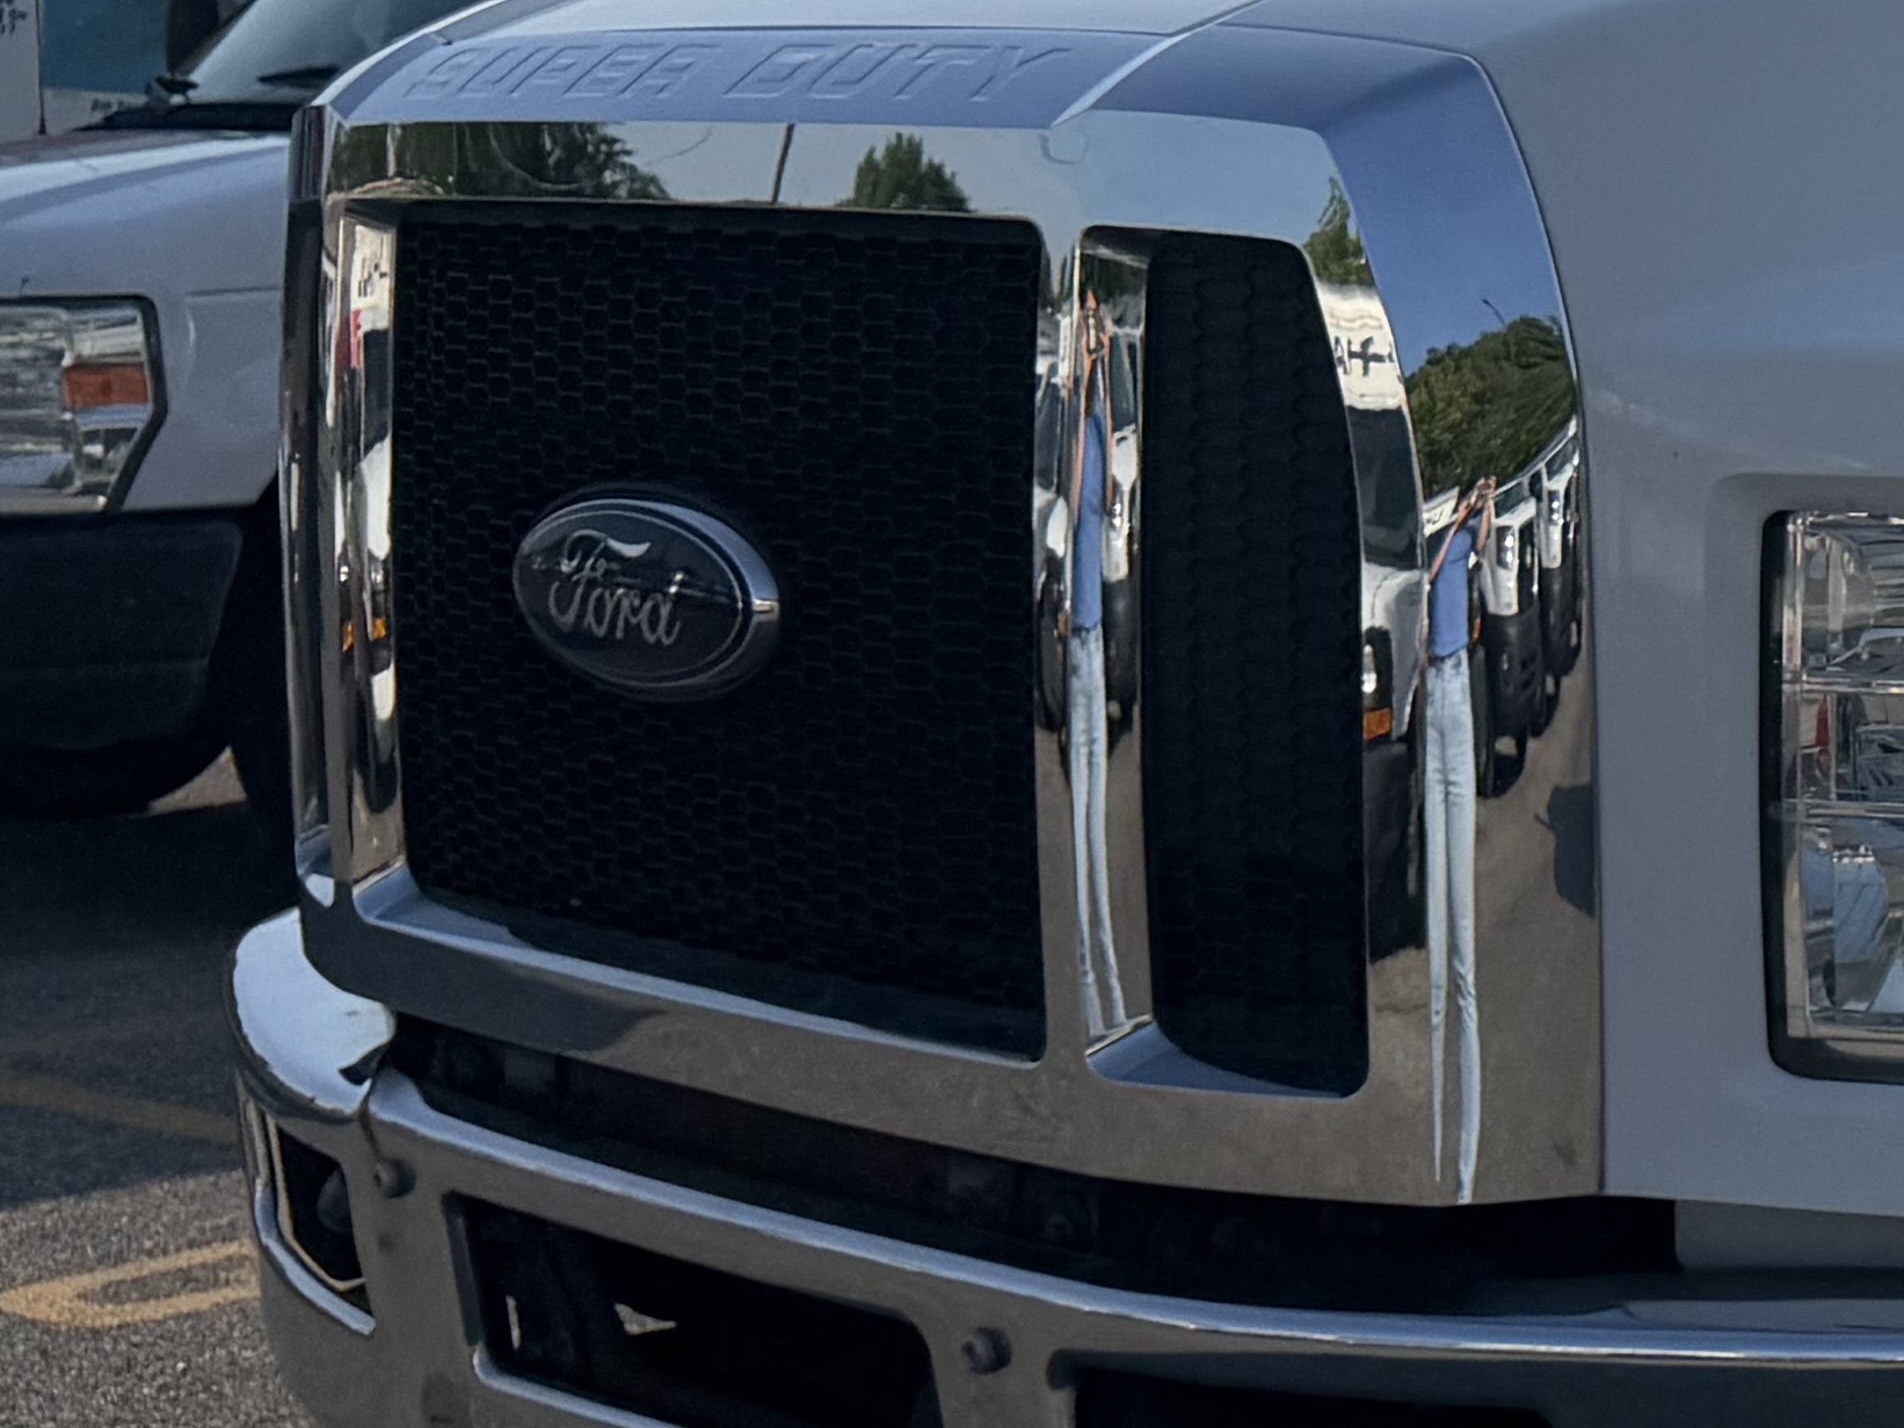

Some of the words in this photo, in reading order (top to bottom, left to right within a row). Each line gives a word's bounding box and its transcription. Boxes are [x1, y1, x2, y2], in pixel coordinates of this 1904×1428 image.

[404, 42, 719, 102] SUPER
[722, 42, 1073, 103] DUTY
[549, 528, 682, 646] Ford
